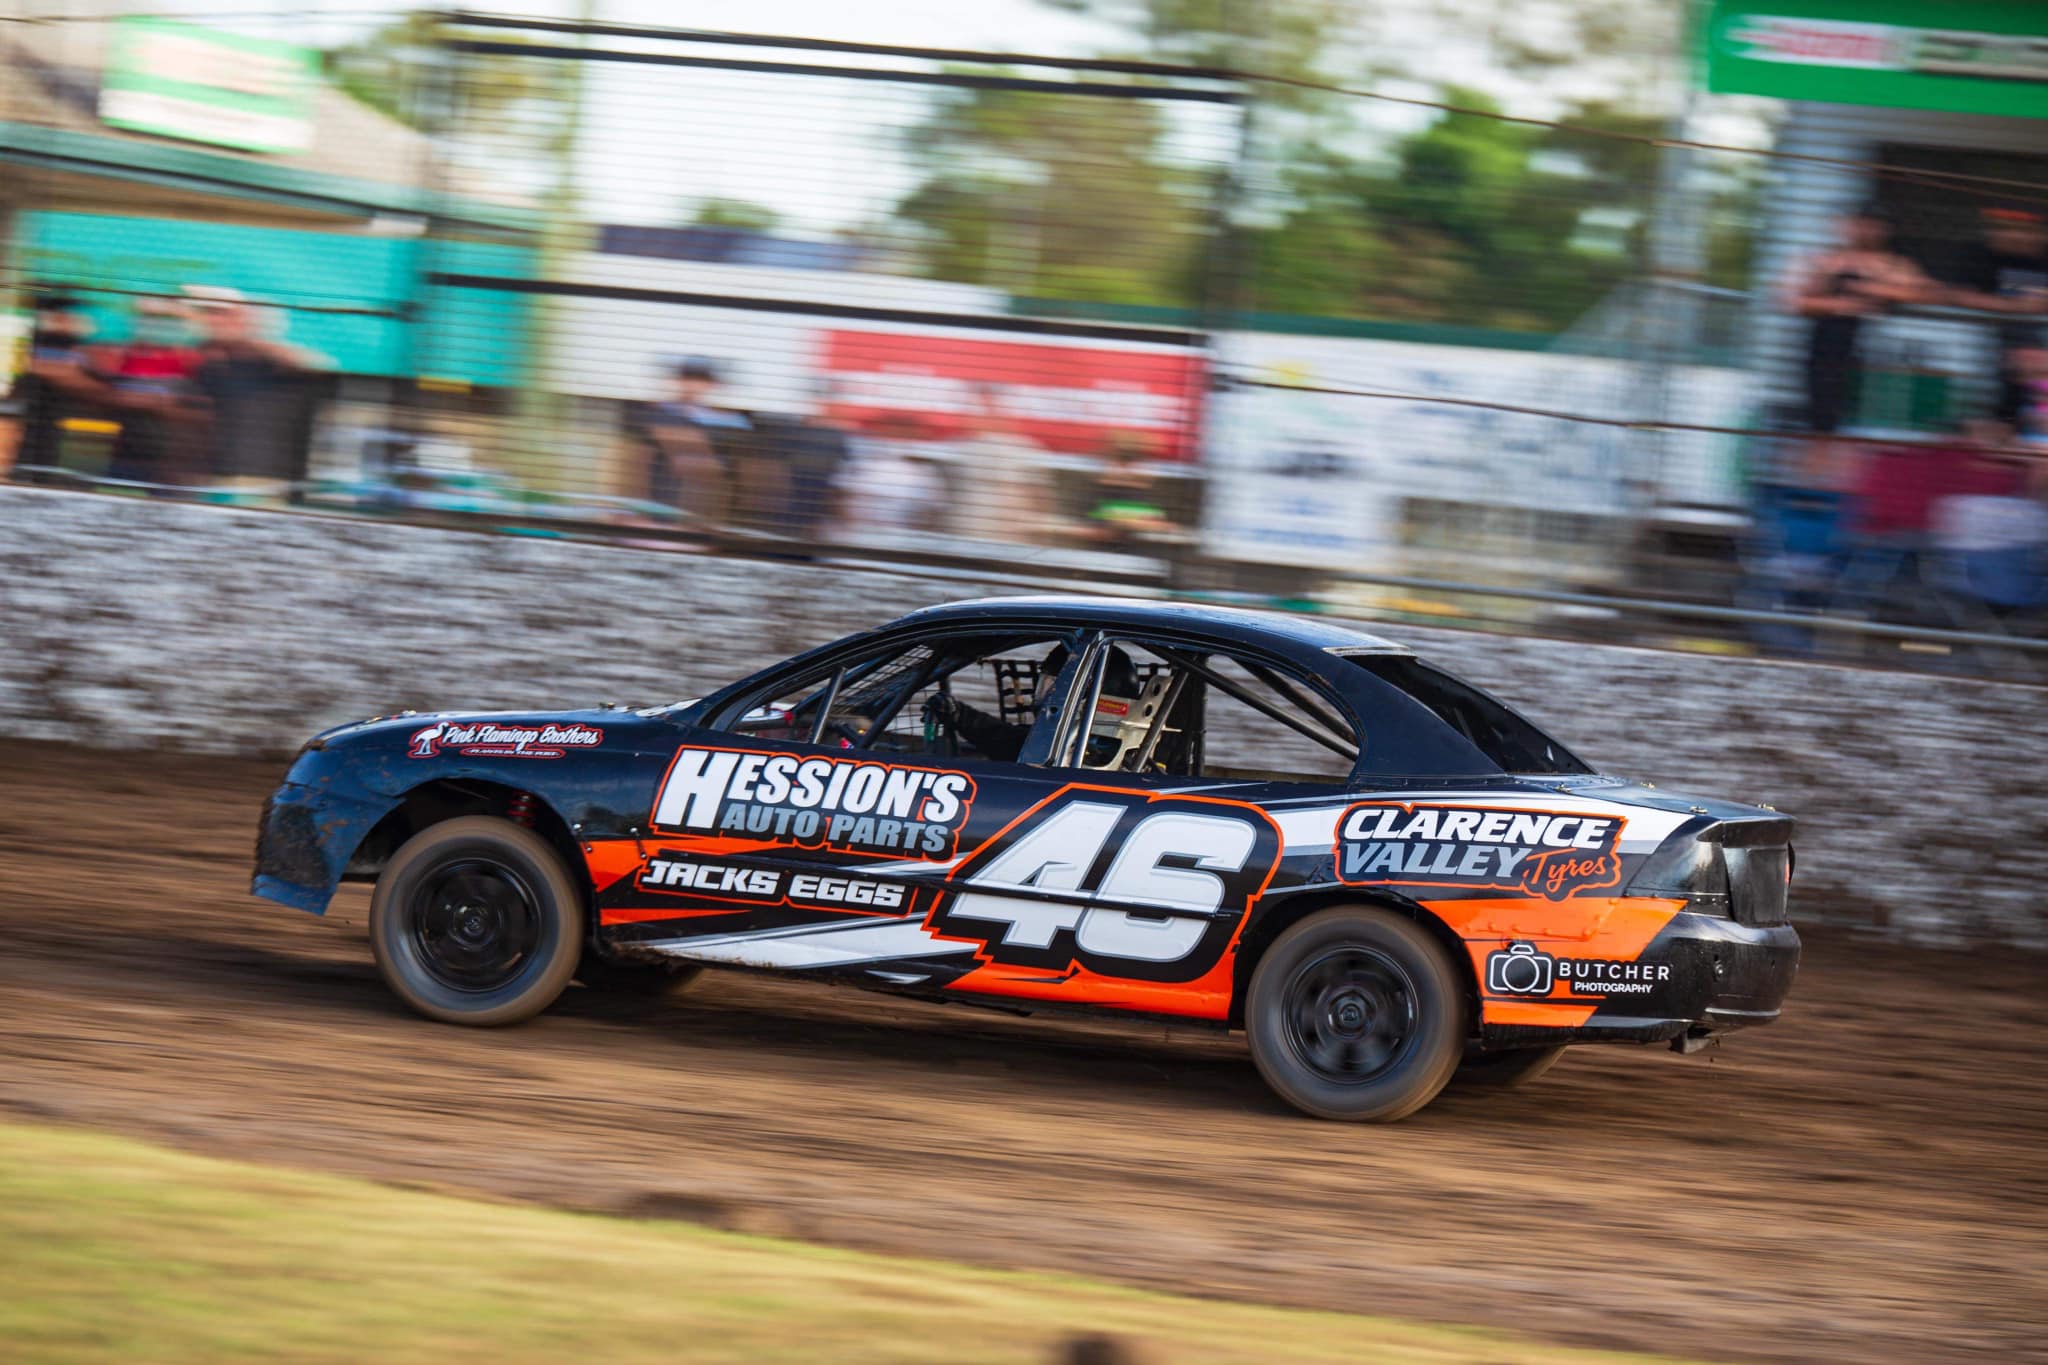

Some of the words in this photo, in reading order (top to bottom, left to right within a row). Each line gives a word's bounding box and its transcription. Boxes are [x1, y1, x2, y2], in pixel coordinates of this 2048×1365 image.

[442, 726, 476, 744] Pink
[474, 725, 539, 751] Flamingo
[539, 726, 598, 744] Brothers
[654, 750, 967, 828] HESSION'S
[719, 803, 821, 838] AUTO
[827, 814, 949, 853] PARTS
[1344, 809, 1612, 849] CLARENCE
[642, 860, 781, 895] JACKS
[788, 875, 906, 907] EGGS
[947, 800, 1257, 962] 46
[1345, 843, 1531, 878] VALLEY
[1523, 847, 1606, 893] Tyres
[1559, 962, 1670, 981] BUTCHER
[1574, 982, 1653, 993] PHOTOGRAPHY
